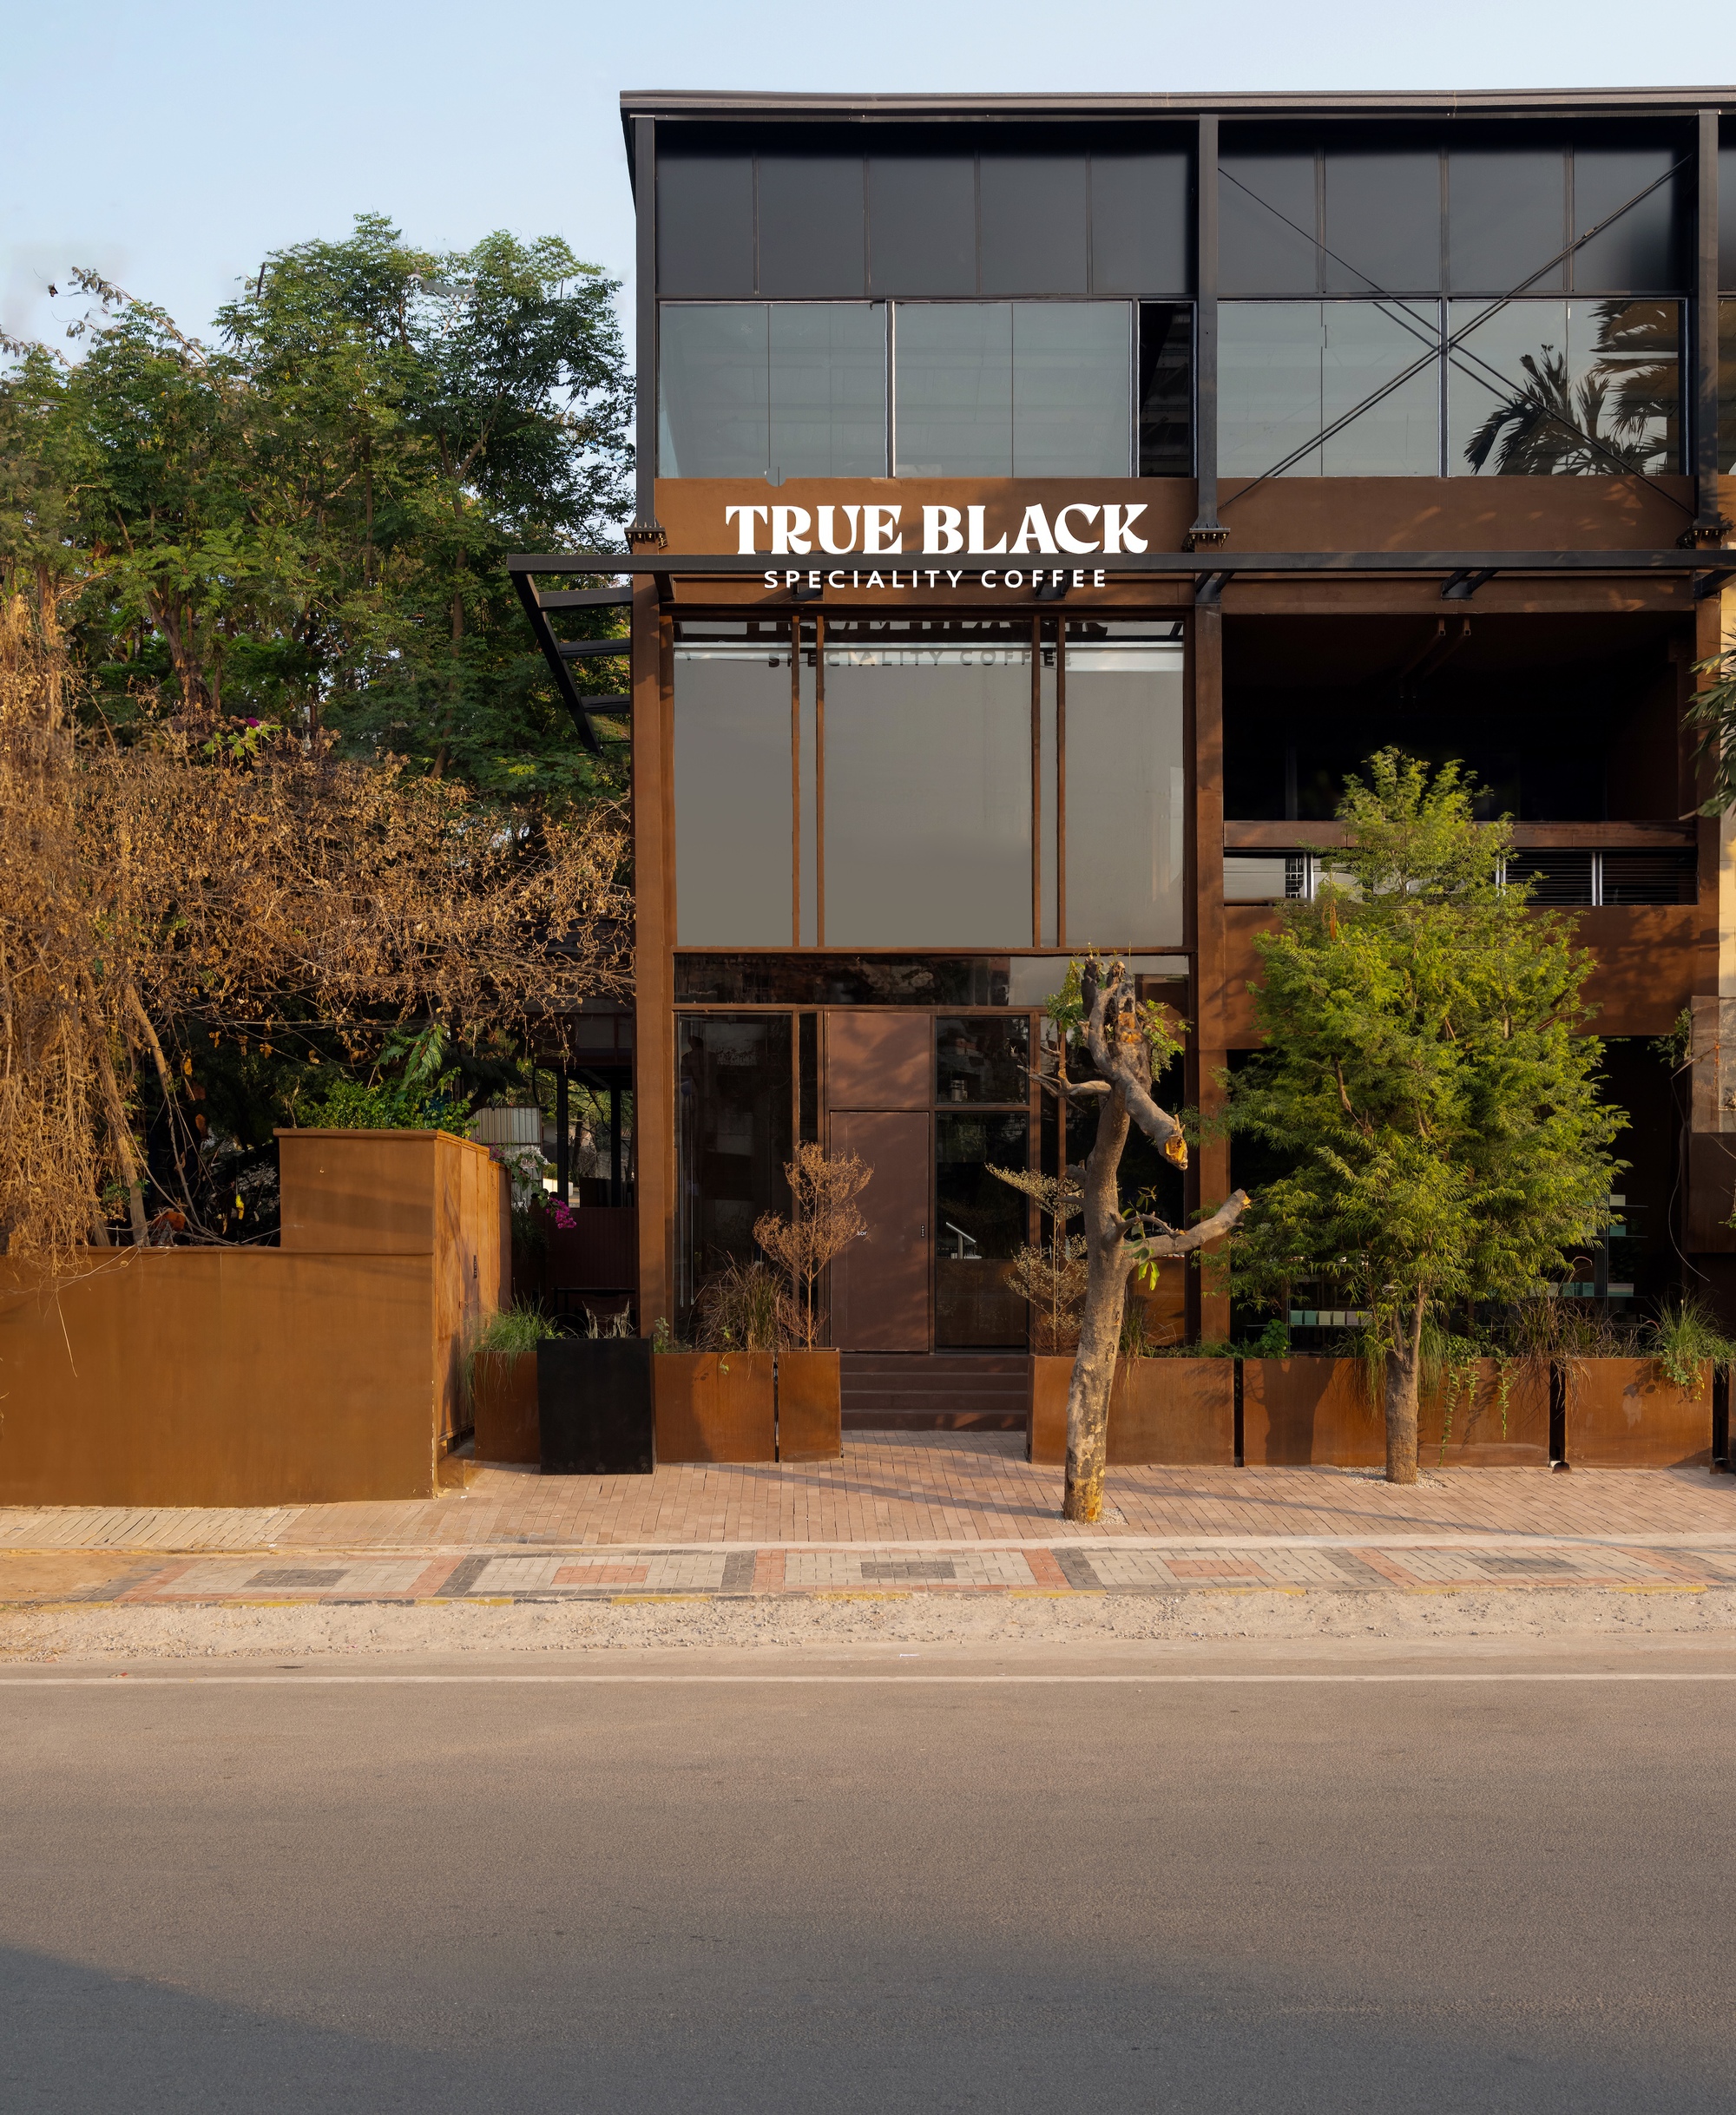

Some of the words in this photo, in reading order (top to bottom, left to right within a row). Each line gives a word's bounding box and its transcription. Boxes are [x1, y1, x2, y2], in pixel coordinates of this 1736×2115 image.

[725, 505, 903, 555] TRUE
[922, 502, 1148, 555] BLACK
[764, 569, 963, 588] SPECIALITY
[981, 568, 1106, 588] COFFEE
